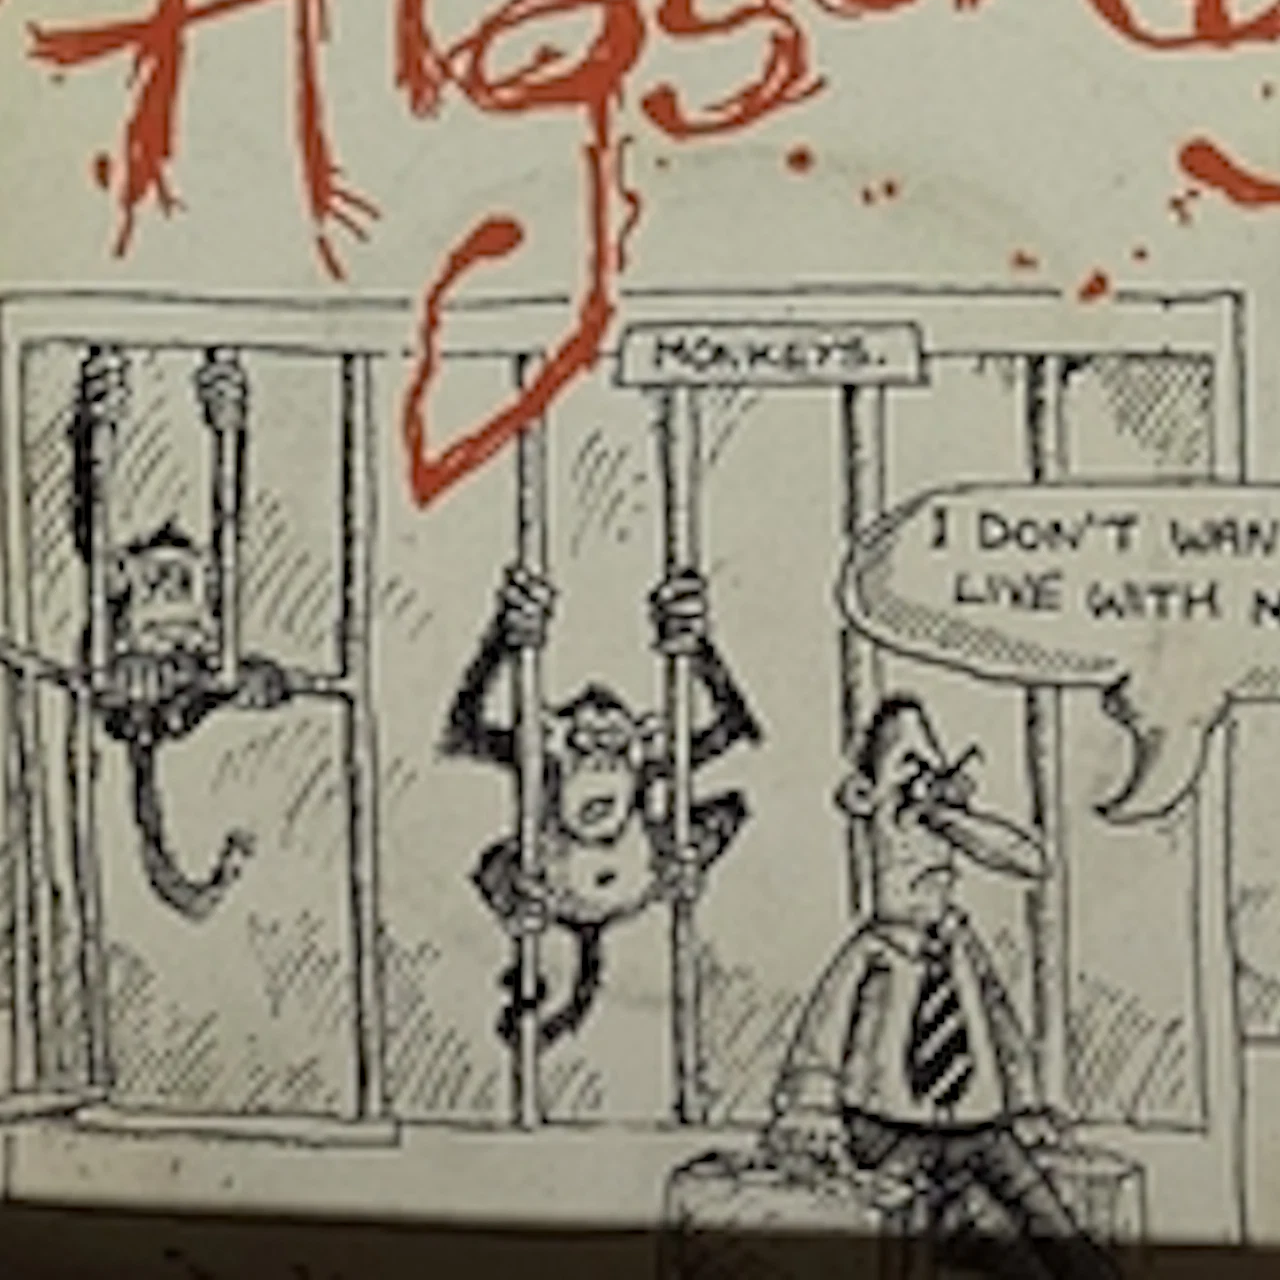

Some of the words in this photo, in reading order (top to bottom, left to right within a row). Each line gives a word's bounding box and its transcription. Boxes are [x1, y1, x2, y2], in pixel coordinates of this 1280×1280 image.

[931, 505, 947, 549] I
[977, 510, 1137, 551] DON'T
[953, 571, 1063, 612] LIVE
[1086, 580, 1220, 620] WITH
